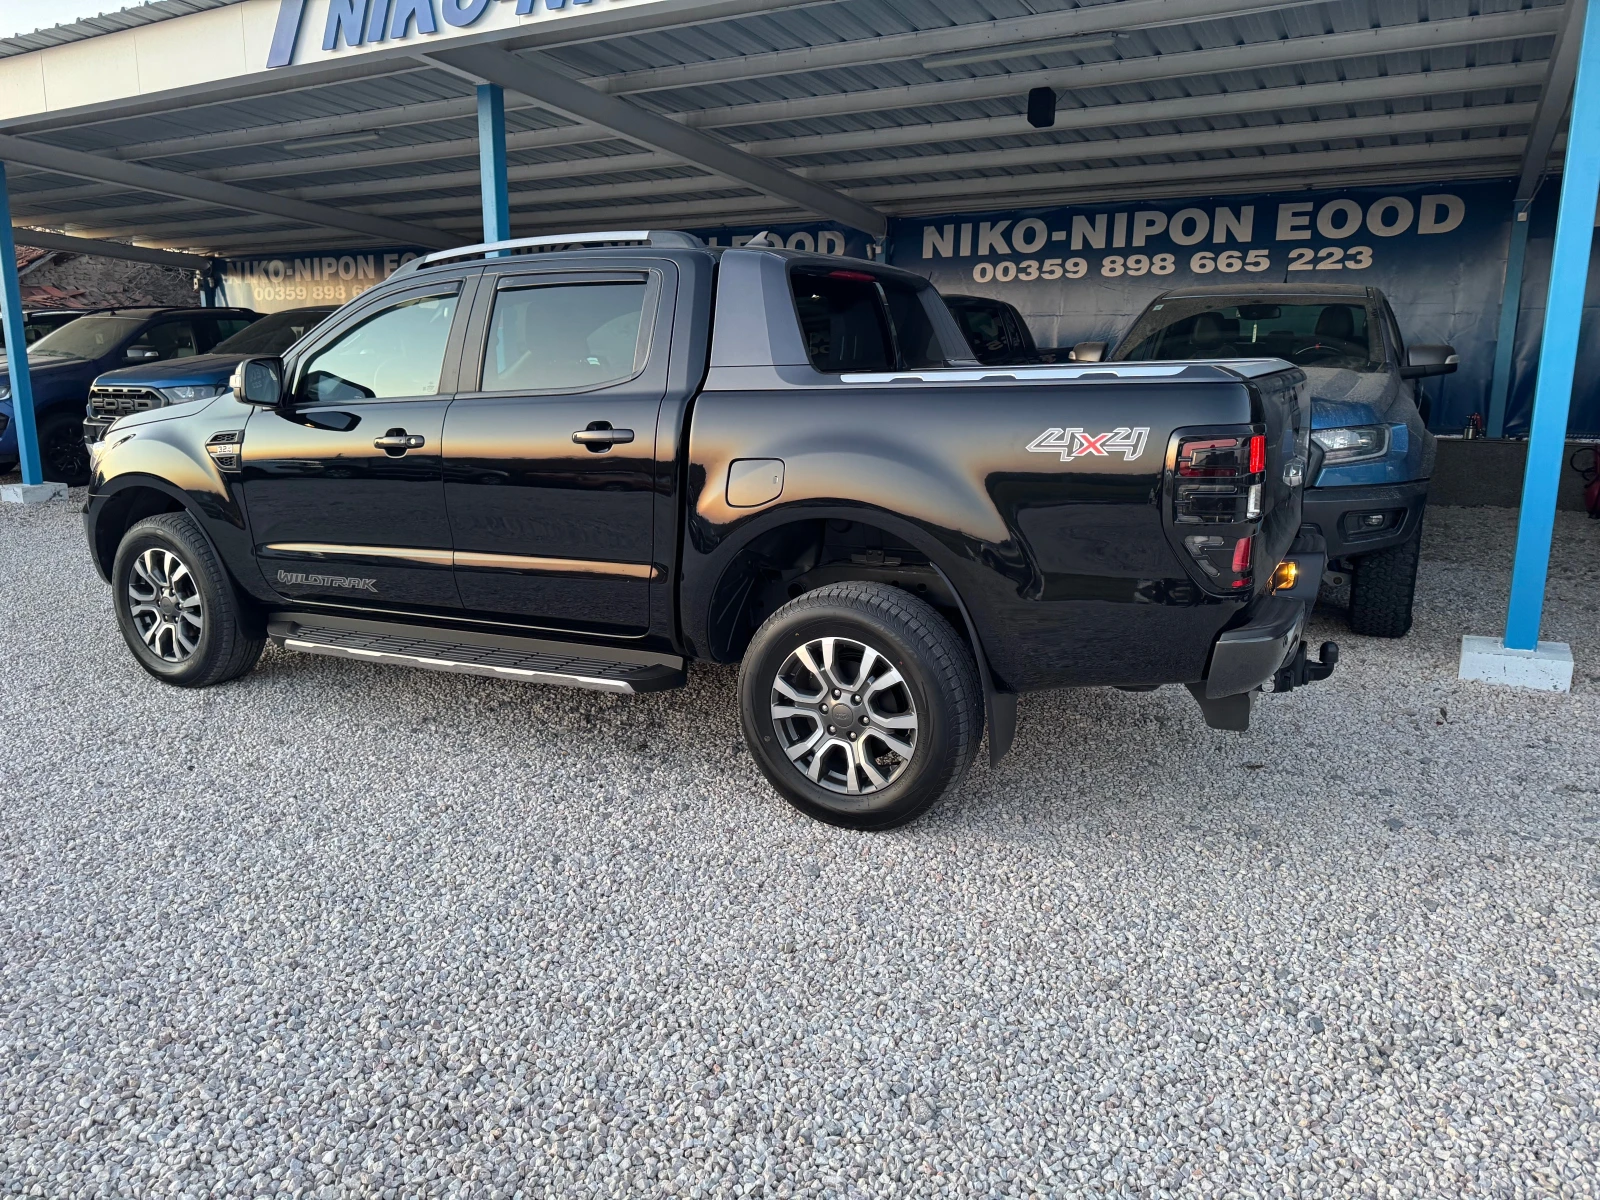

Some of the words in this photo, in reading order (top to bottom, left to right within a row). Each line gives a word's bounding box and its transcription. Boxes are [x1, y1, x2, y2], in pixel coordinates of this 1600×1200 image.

[922, 205, 1254, 259] NIKO-NIPON
[1275, 194, 1465, 241] EOOD
[226, 254, 375, 284] NIKO-NIPON
[972, 257, 1088, 283] 00359
[1100, 253, 1175, 277] 898
[1190, 249, 1270, 274] 665
[1287, 246, 1373, 271] 223
[253, 286, 307, 301] 00359
[312, 285, 346, 300] 898
[91, 398, 152, 411] FORD
[277, 570, 379, 593] WILDTRAK
